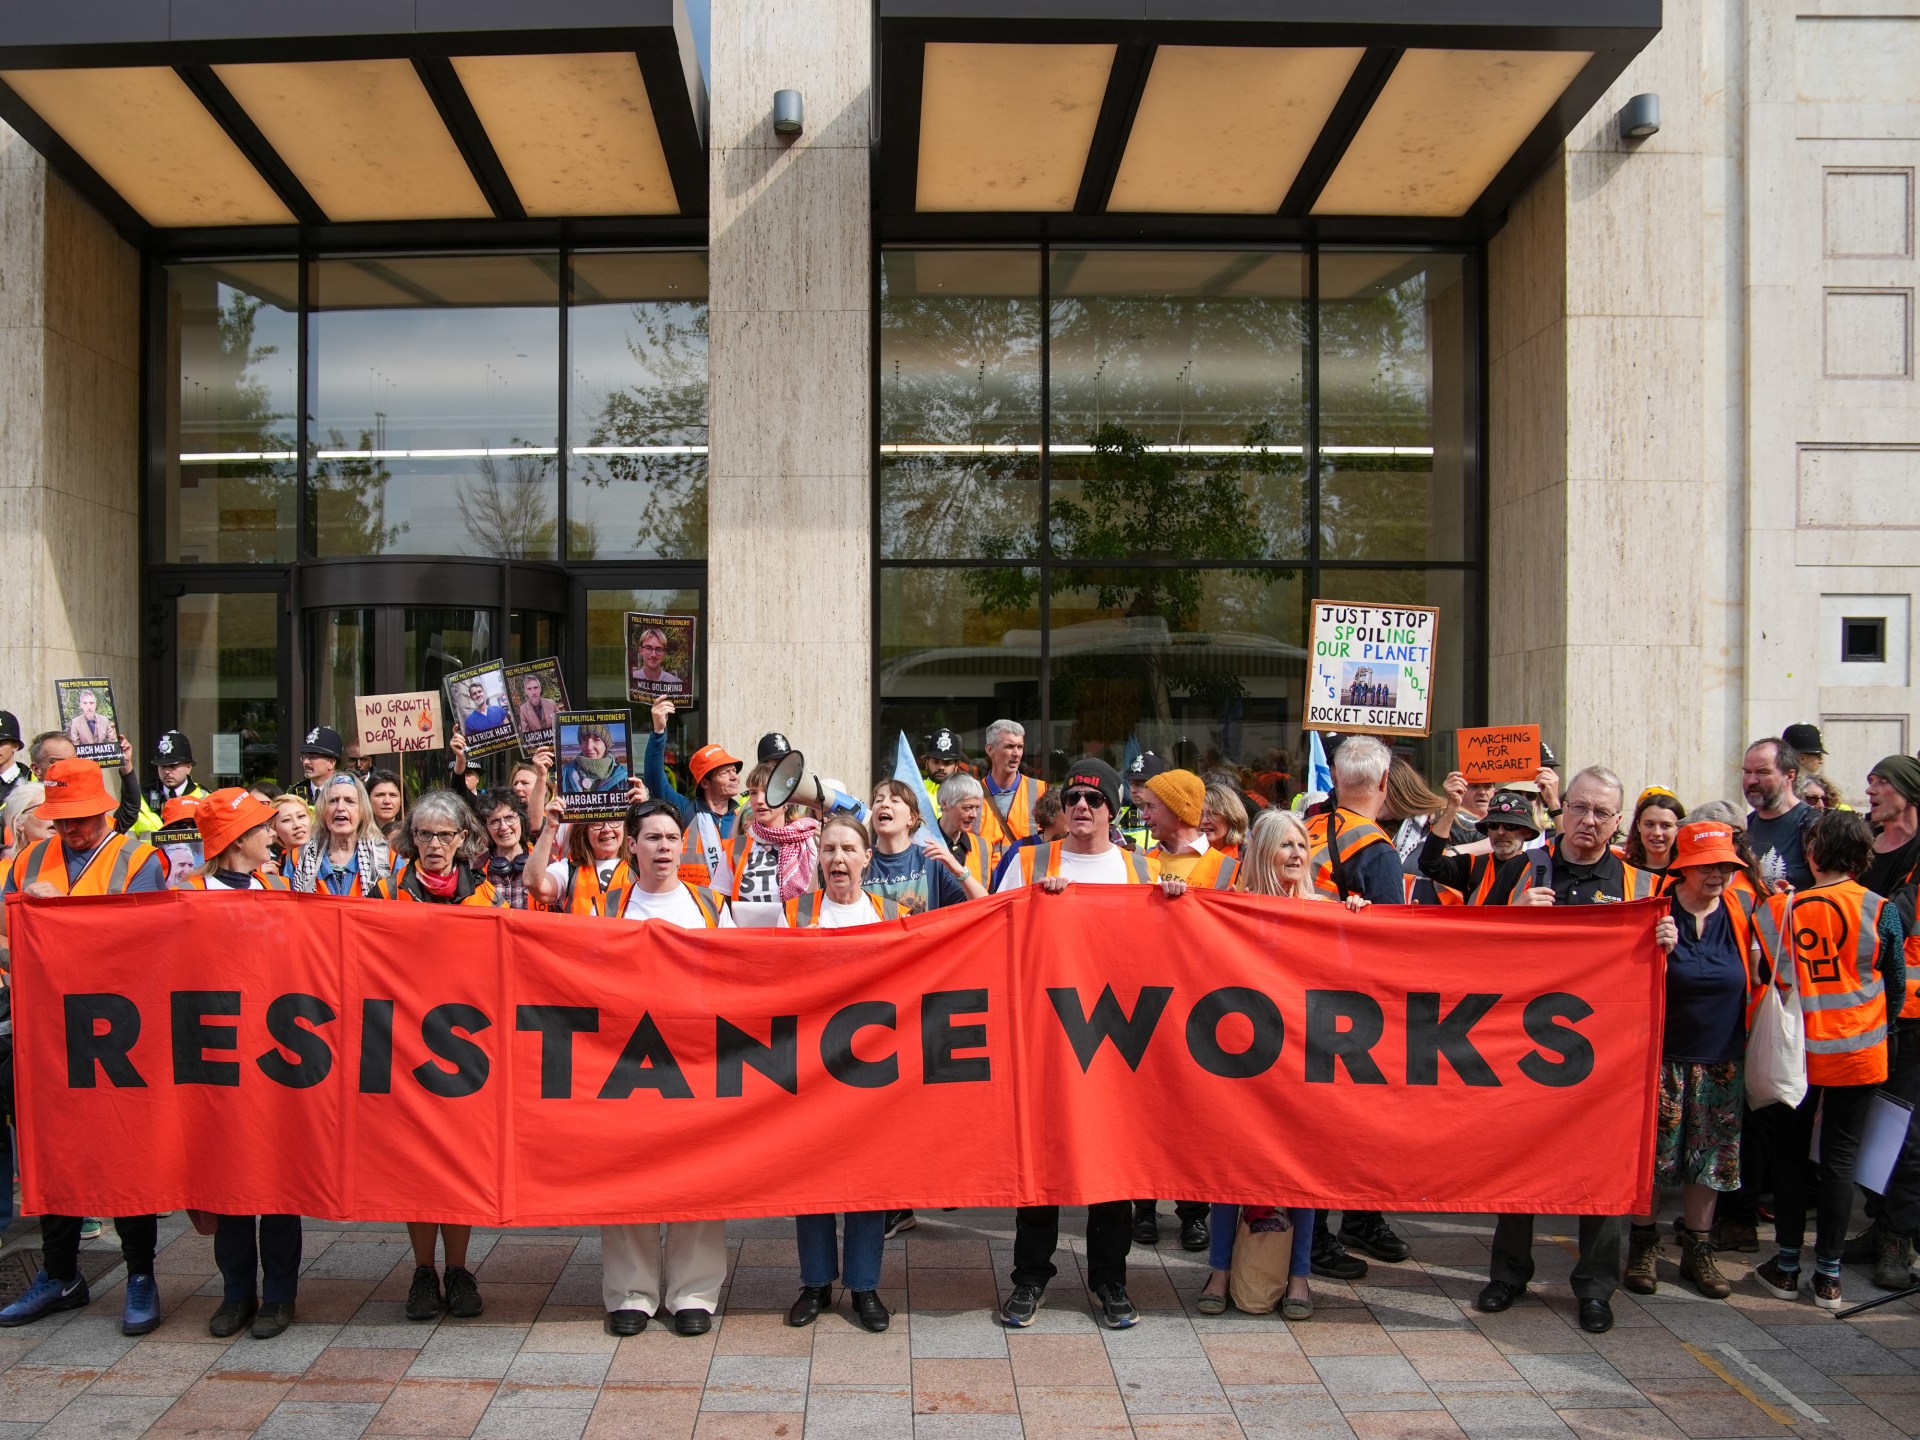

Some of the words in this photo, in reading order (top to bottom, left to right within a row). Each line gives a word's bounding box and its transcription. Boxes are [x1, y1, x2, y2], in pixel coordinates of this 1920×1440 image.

[1322, 607, 1370, 625] JUST
[1381, 610, 1428, 628] STOP
[1334, 625, 1416, 645] SPOILING
[1317, 640, 1350, 658] OUR
[1363, 643, 1428, 662] PLANET
[651, 683, 683, 692] GOLDRING
[1404, 666, 1425, 700] NOT
[365, 702, 382, 716] NO
[388, 698, 431, 713] GROWTH
[381, 716, 397, 728] ON
[403, 715, 411, 726] A
[571, 714, 596, 722] POLITICAL
[596, 713, 626, 721] PRISONERS
[1310, 706, 1361, 722] ROCKET
[1368, 710, 1423, 726] SCIENCE
[365, 729, 396, 743] DEAD
[467, 732, 494, 744] PATRICK
[495, 724, 513, 737] HART
[524, 731, 542, 742] LARCH
[1468, 733, 1531, 748] MARCHING
[76, 745, 94, 755] ARCH
[94, 744, 116, 754] MAXEY
[390, 734, 435, 752] PLANET
[1487, 745, 1510, 757] FOR
[1466, 757, 1532, 774] MARGARET
[1075, 774, 1100, 787] hell
[561, 793, 608, 806] MARGARET
[155, 834, 167, 842] FREE
[167, 833, 193, 842] POLITICAL
[748, 850, 778, 870] US
[63, 988, 992, 1100] RESISTANCE
[1045, 982, 1596, 1088] WORKS
